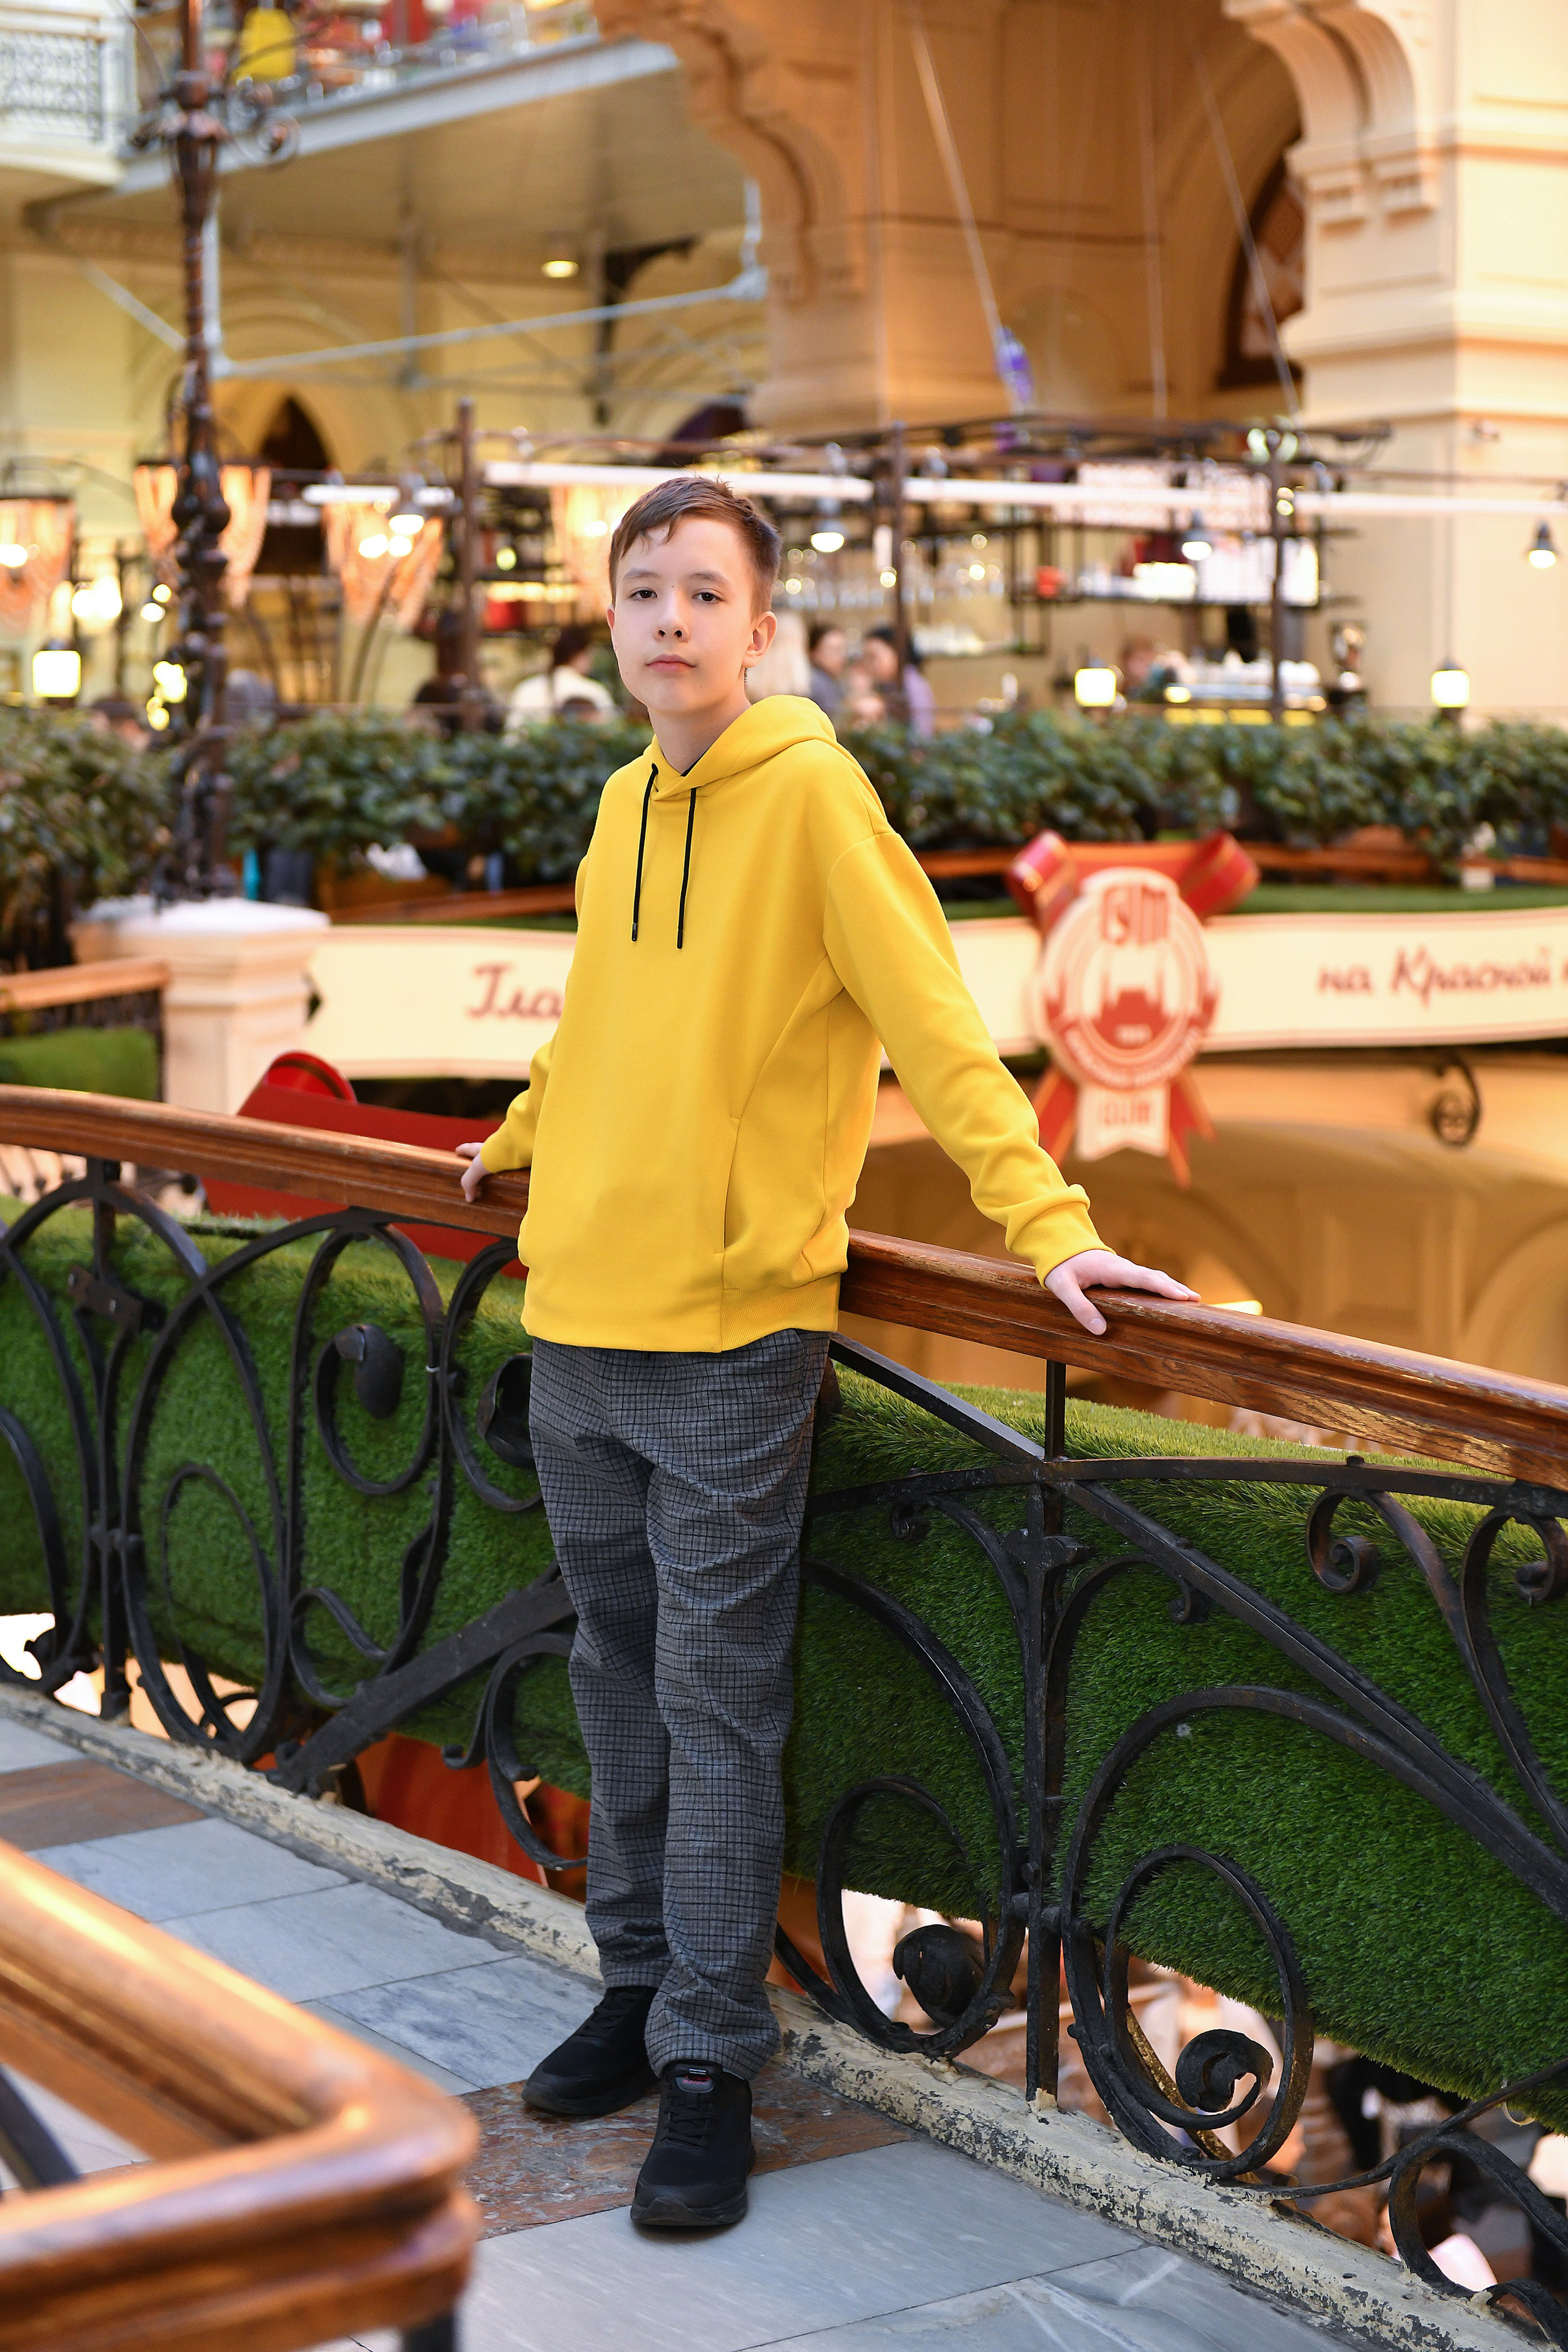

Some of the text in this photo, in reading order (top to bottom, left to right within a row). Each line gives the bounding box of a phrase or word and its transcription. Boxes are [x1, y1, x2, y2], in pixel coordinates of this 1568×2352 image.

[467, 962, 563, 1020] Гла
[1318, 963, 1372, 993] на
[1389, 944, 1551, 1008] Красной
